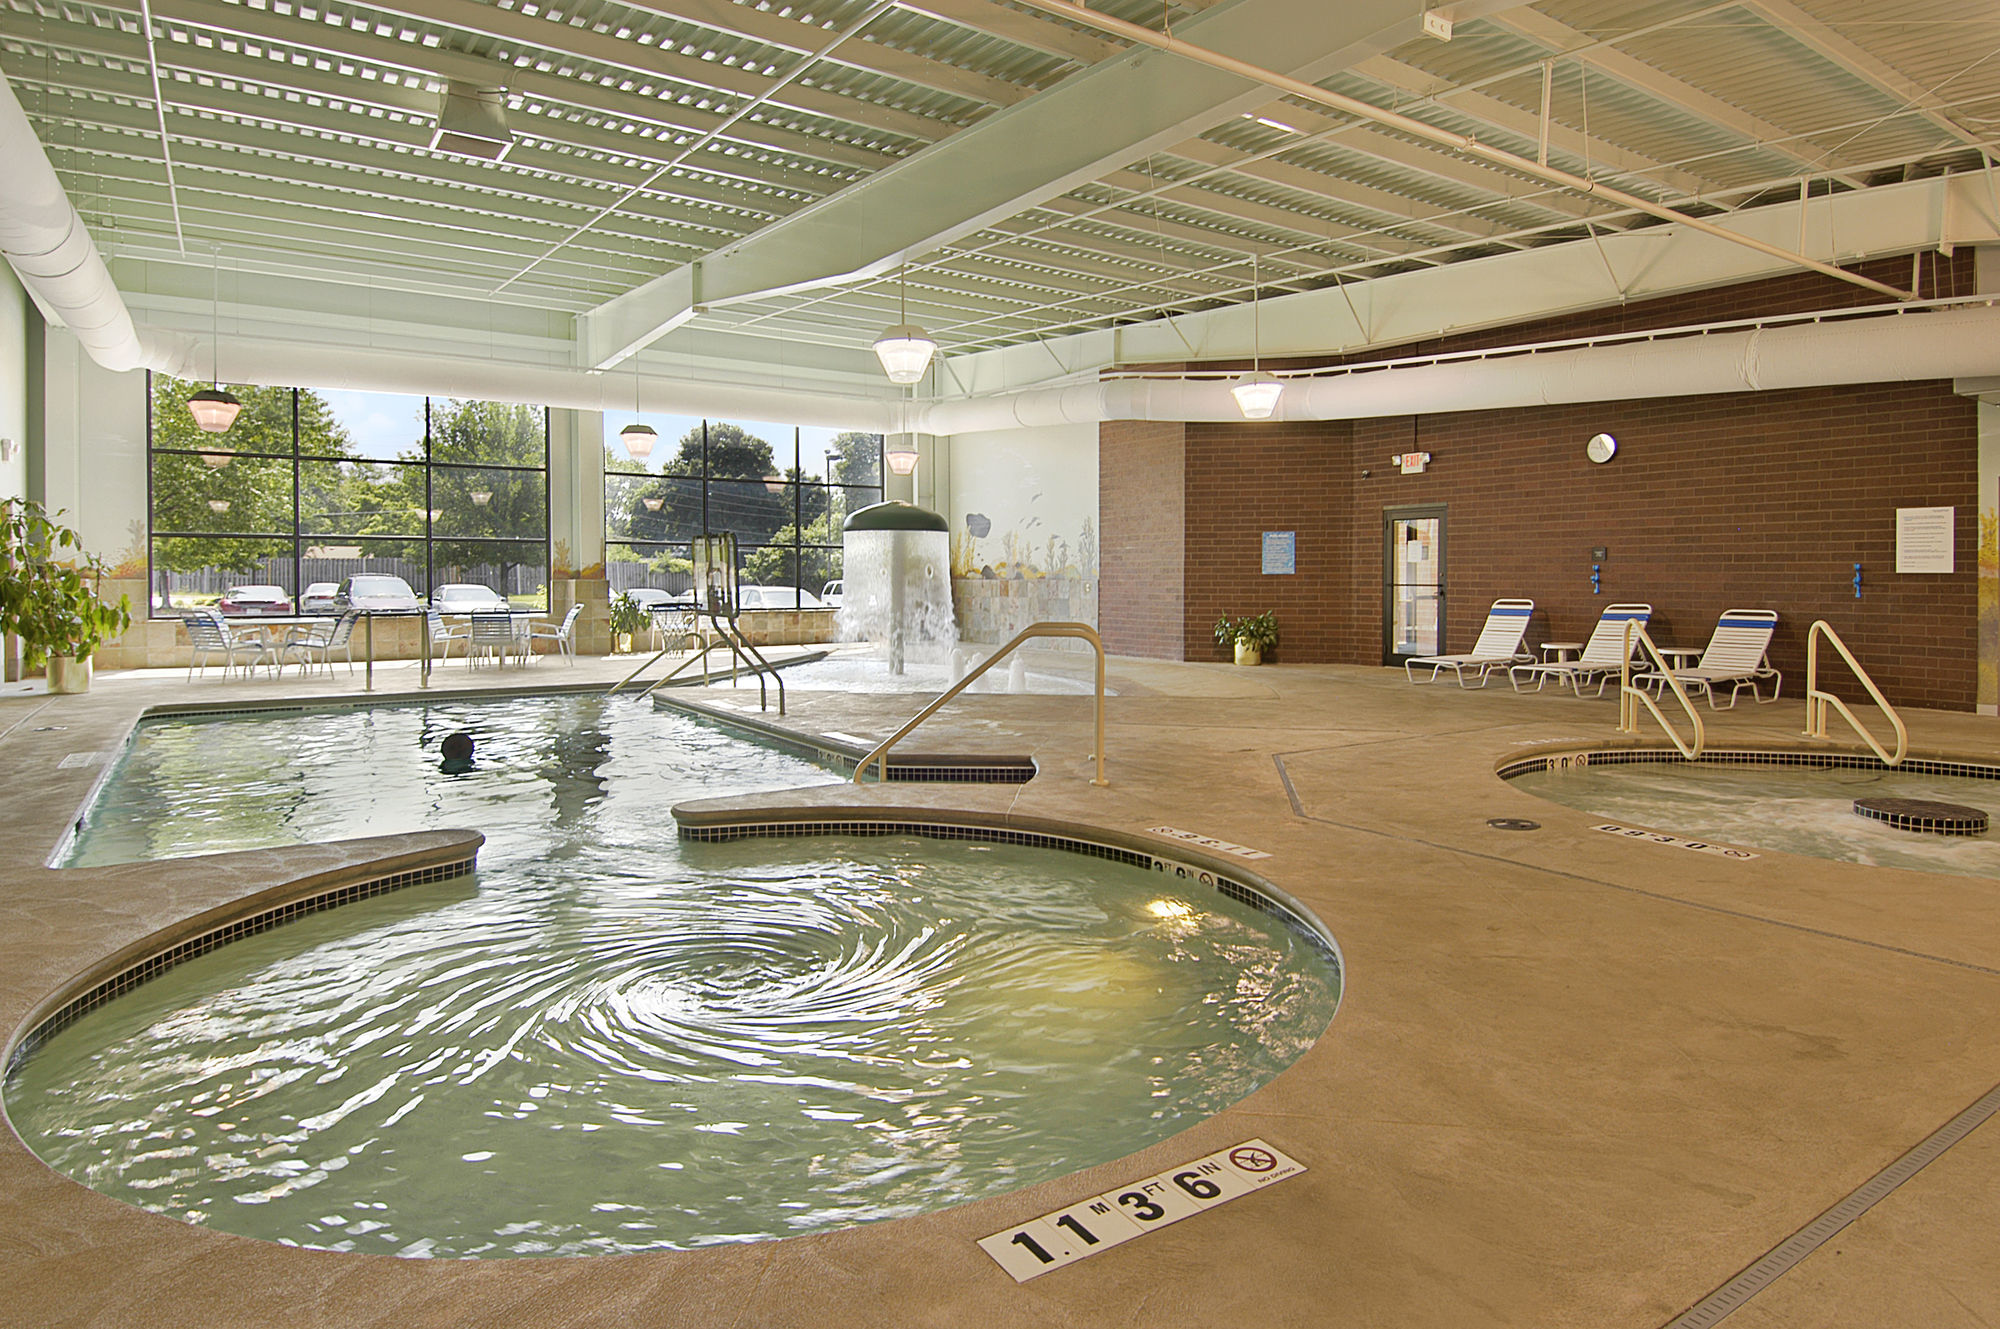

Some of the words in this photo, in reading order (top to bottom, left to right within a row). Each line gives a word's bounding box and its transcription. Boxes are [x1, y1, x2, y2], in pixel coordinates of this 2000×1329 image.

[1405, 454, 1420, 467] EXIT
[1270, 1166, 1296, 1179] DIVING
[1088, 1201, 1111, 1215] M
[1117, 1191, 1165, 1221] 3
[1141, 1181, 1166, 1197] FT
[1172, 1171, 1221, 1199] 6
[1197, 1161, 1222, 1176] IN
